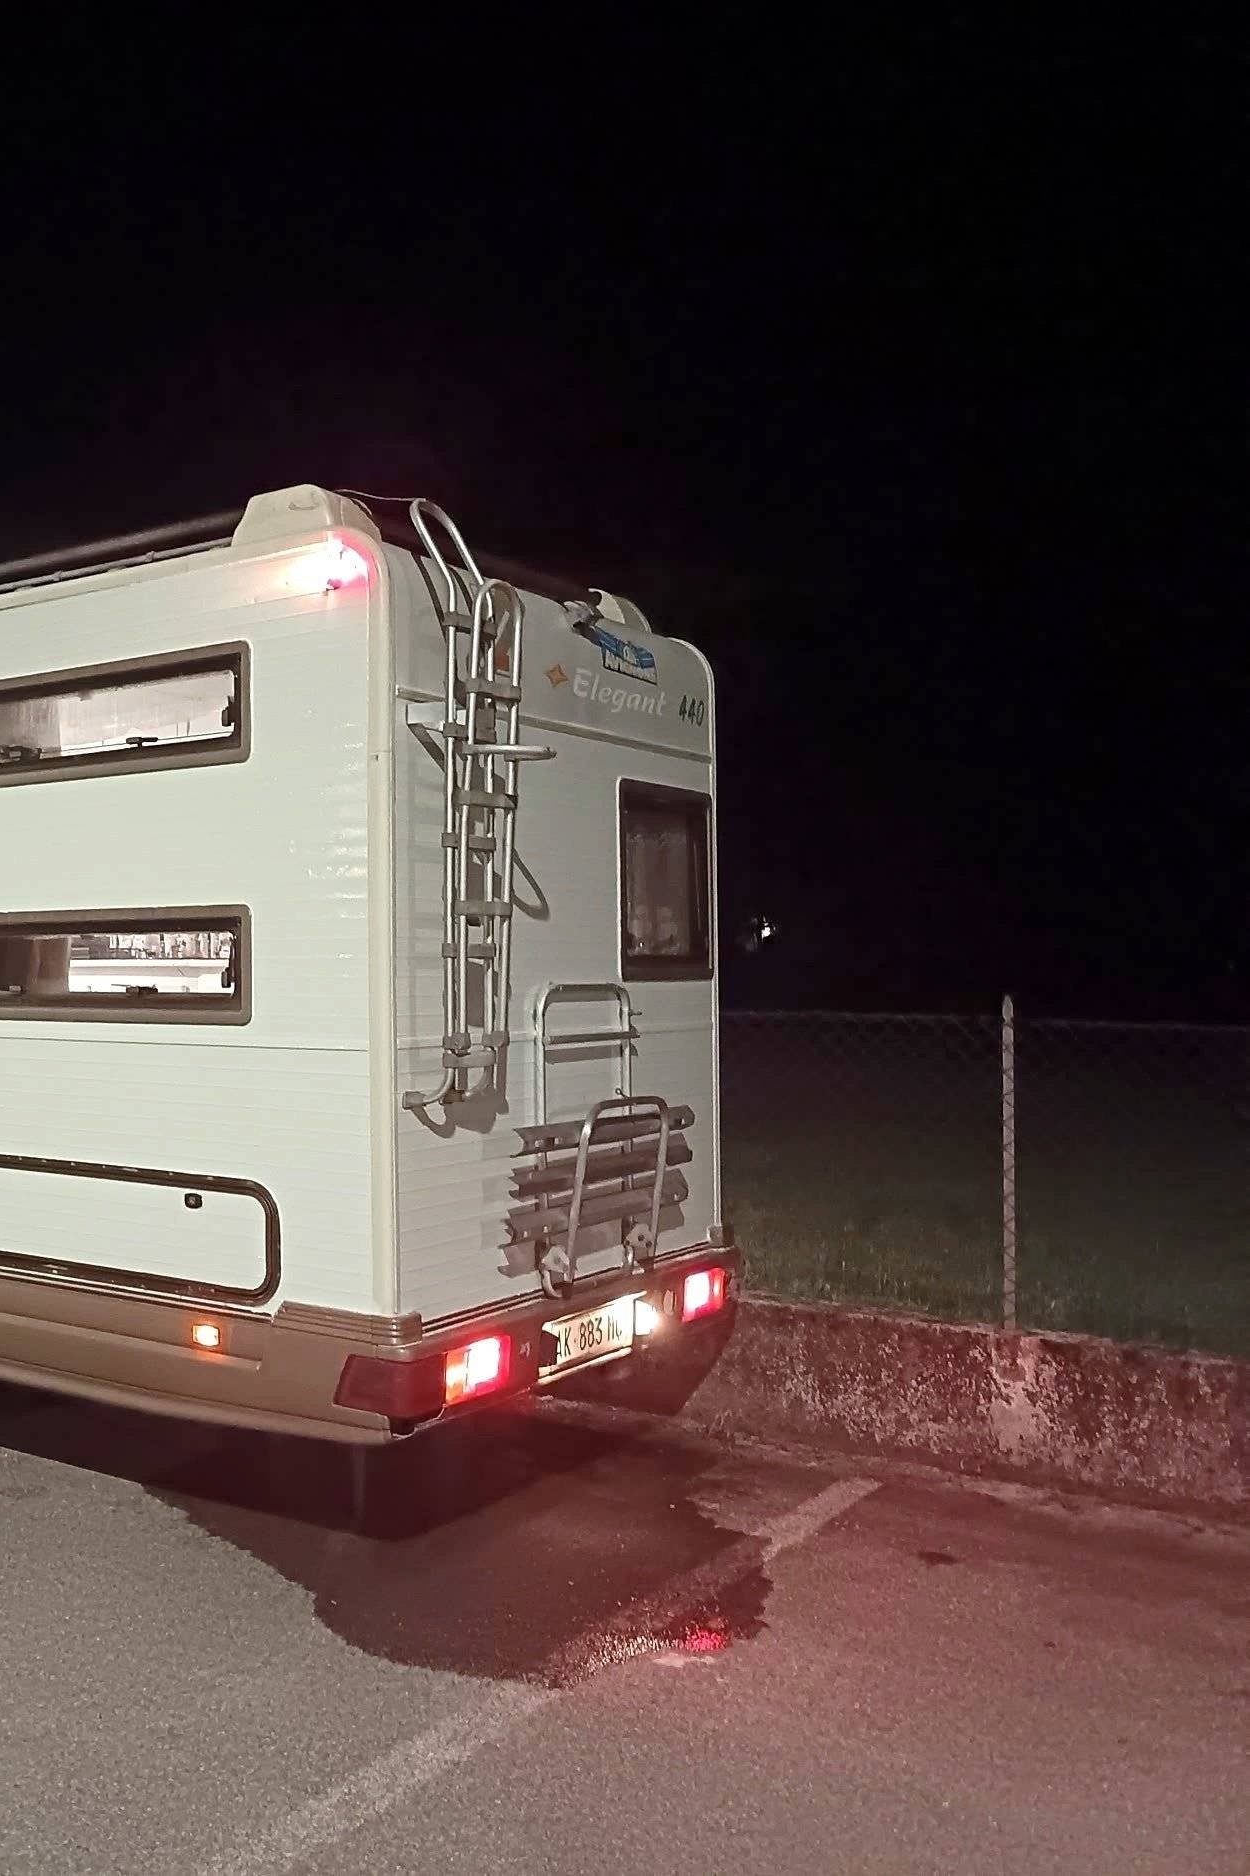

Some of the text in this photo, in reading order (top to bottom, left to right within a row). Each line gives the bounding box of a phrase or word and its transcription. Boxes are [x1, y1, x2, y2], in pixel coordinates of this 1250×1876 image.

[573, 667, 704, 727] Elegant 440
[579, 1316, 603, 1351] 883
